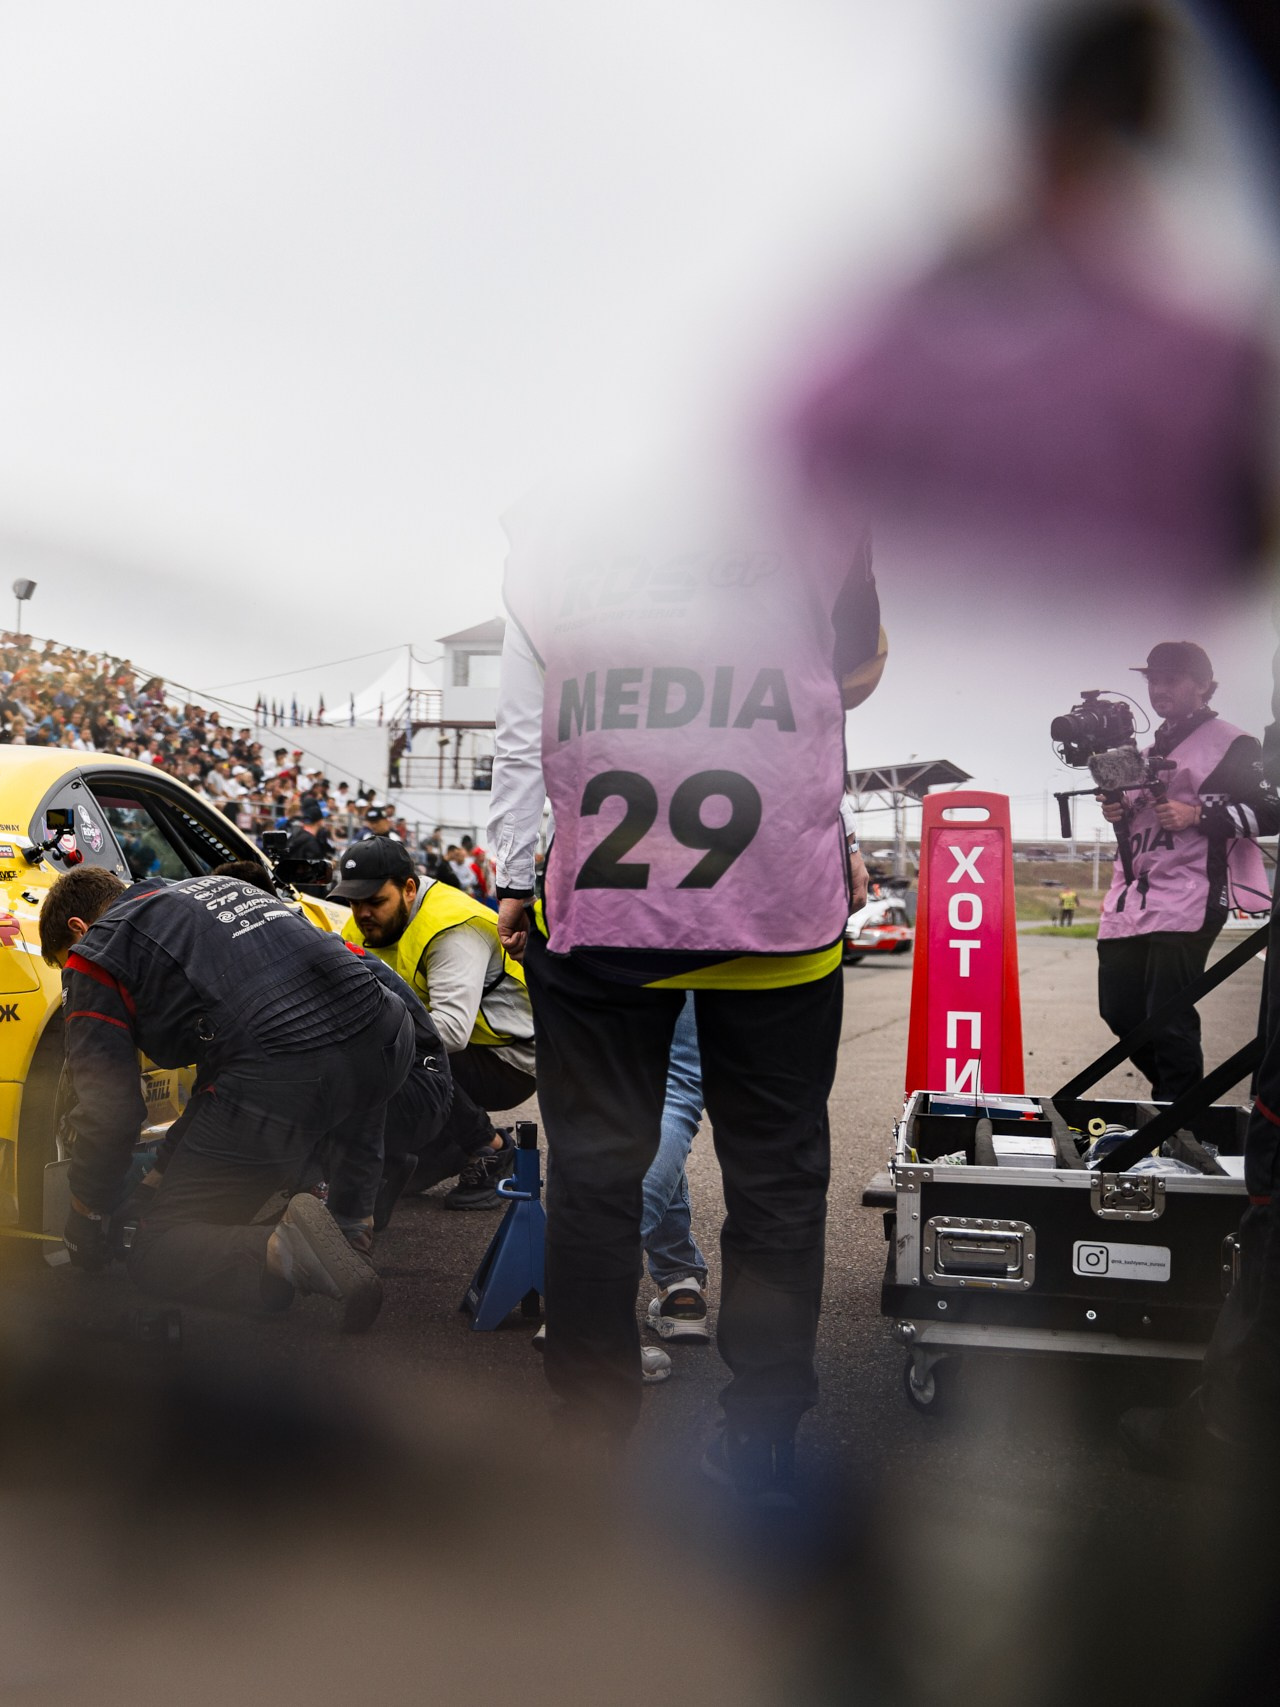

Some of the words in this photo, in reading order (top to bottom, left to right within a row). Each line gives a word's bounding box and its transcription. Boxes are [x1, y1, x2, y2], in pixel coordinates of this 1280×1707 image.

[558, 666, 797, 743] MEDIA
[574, 769, 762, 891] 29
[1129, 827, 1174, 853] DIA
[947, 846, 985, 977] ХОТ
[946, 1011, 982, 1094] ПИ
